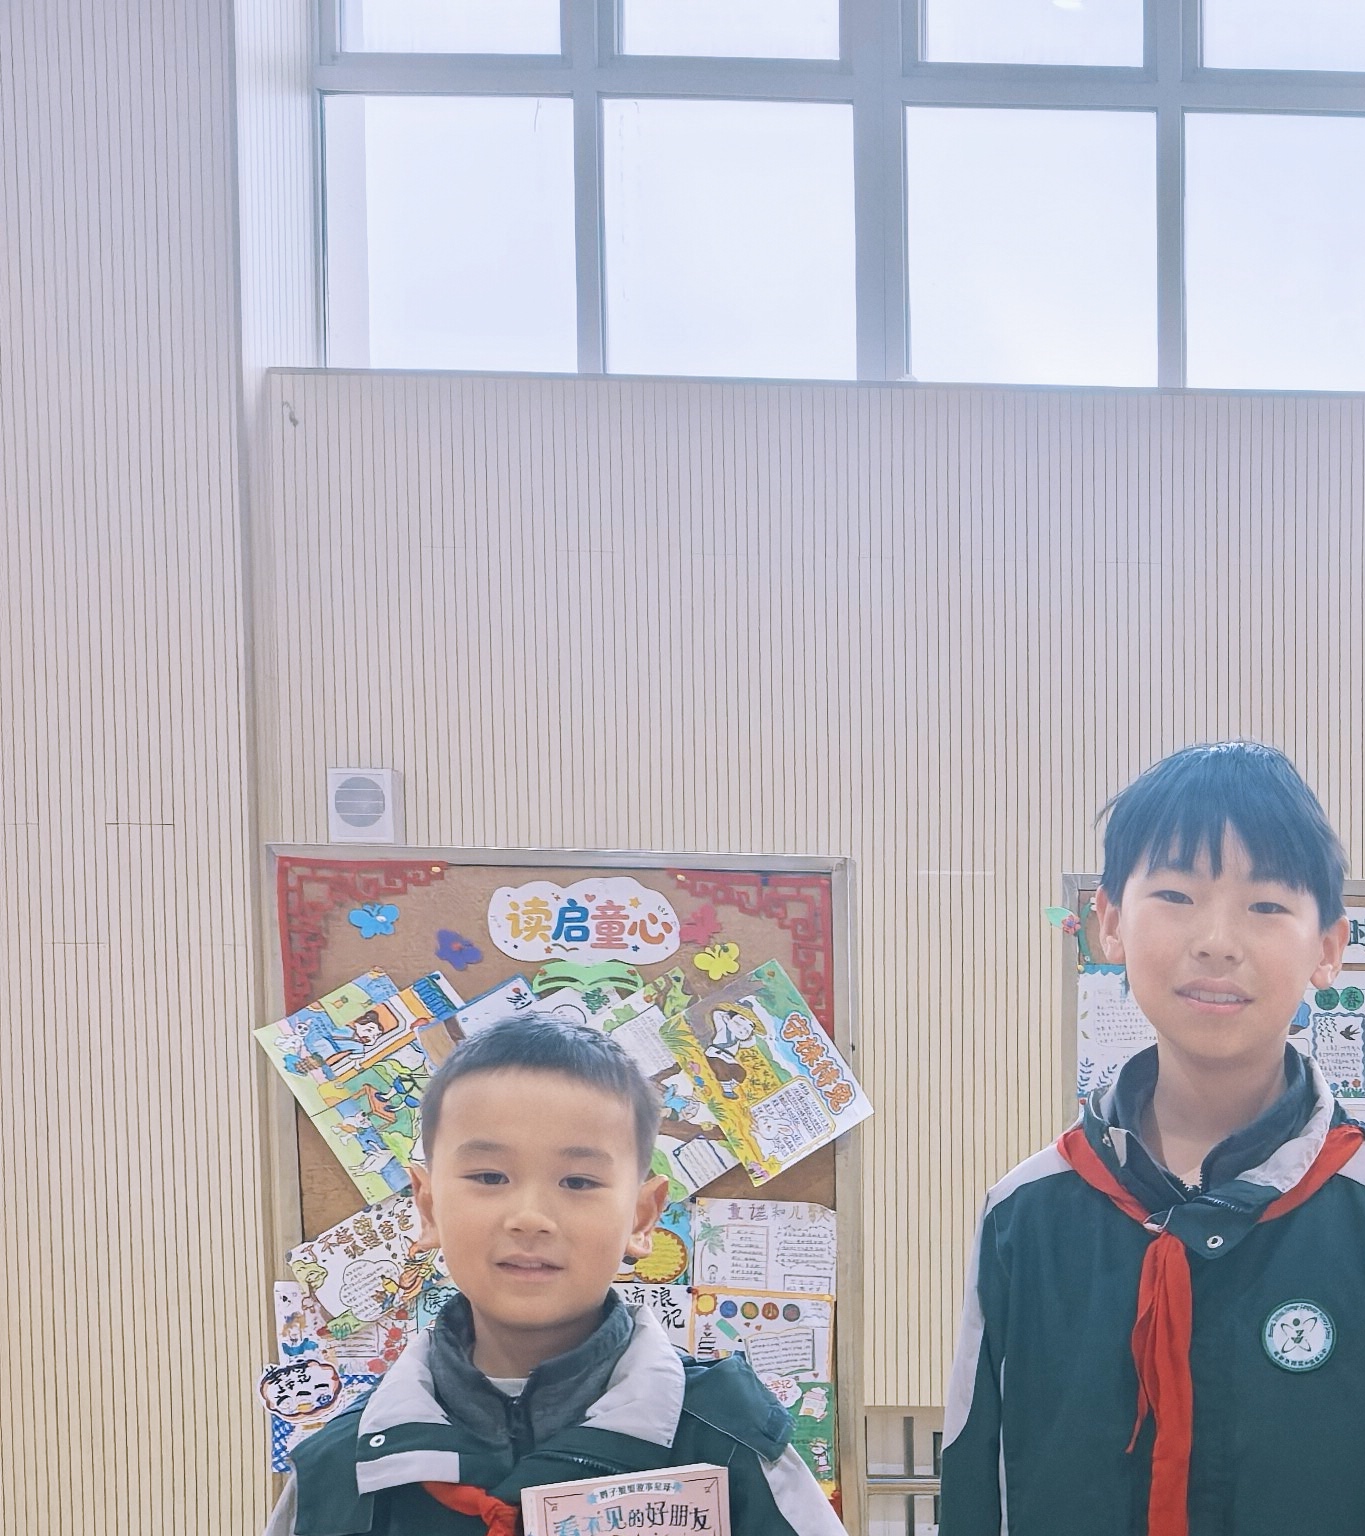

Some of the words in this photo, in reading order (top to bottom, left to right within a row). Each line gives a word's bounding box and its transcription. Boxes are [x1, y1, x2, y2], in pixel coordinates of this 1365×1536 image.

[506, 896, 673, 950] 读启童心
[783, 1013, 853, 1113] 守株待兔
